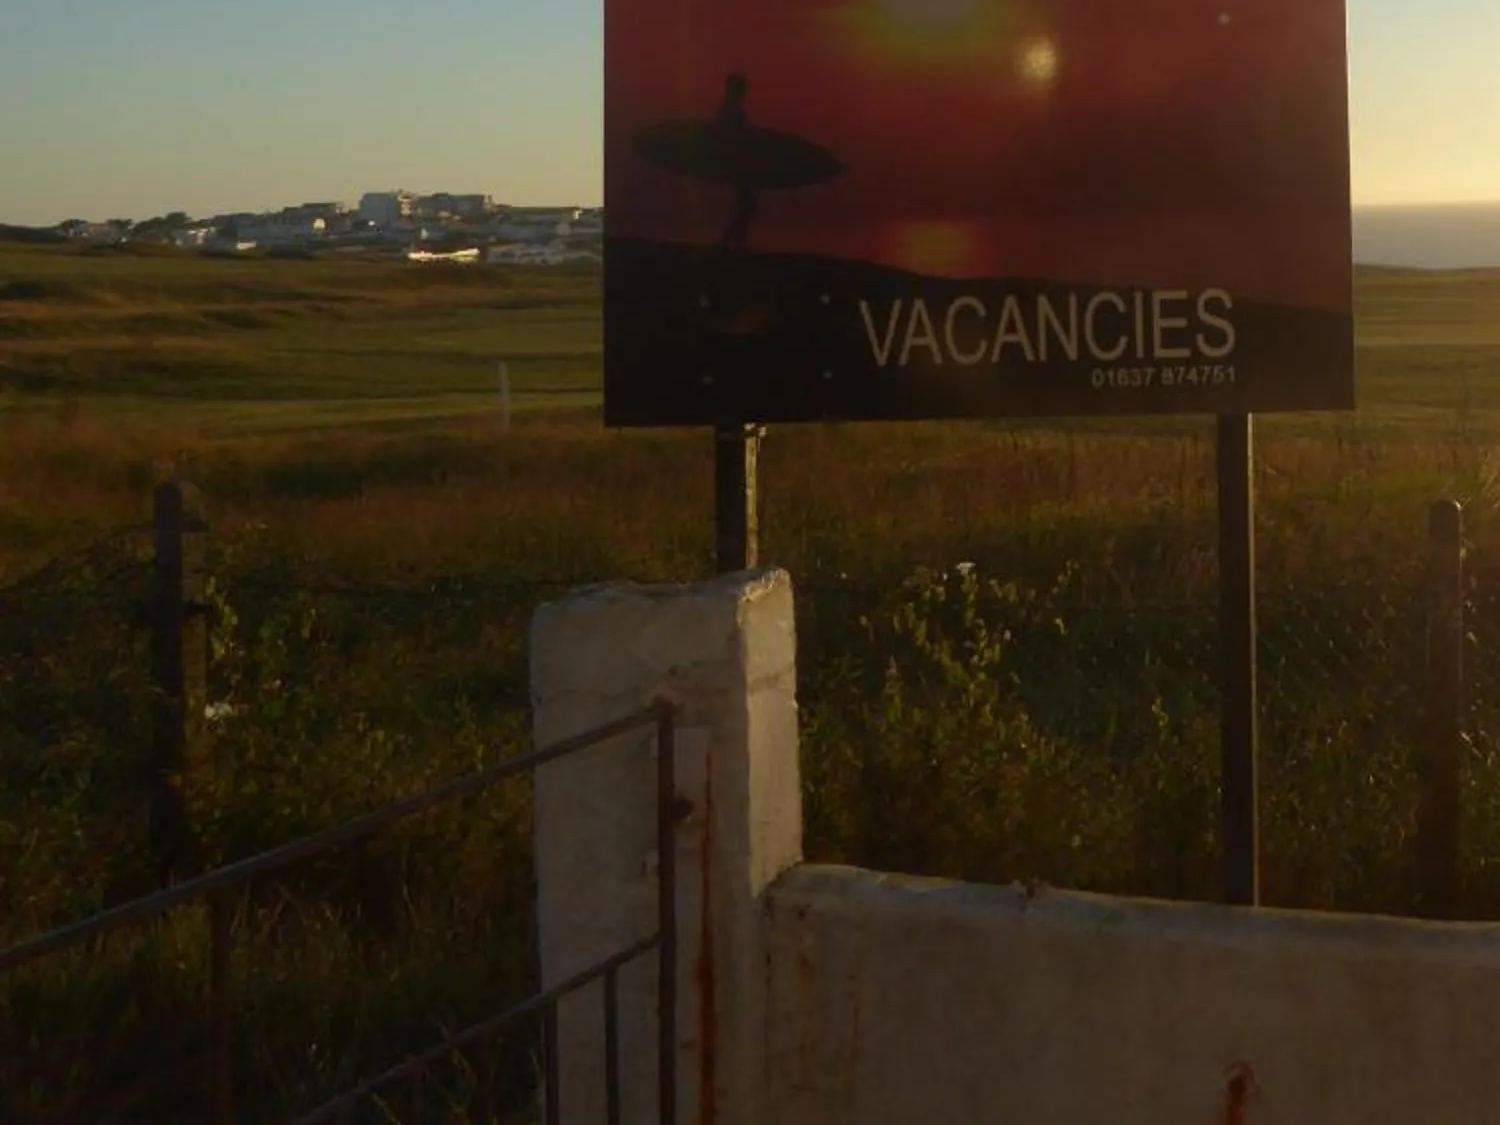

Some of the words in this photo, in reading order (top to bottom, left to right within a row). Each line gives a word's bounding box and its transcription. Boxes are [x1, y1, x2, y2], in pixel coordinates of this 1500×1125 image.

[861, 288, 1235, 366] VACANCIES
[1091, 367, 1156, 388] 01637
[1161, 365, 1236, 385] 874751
